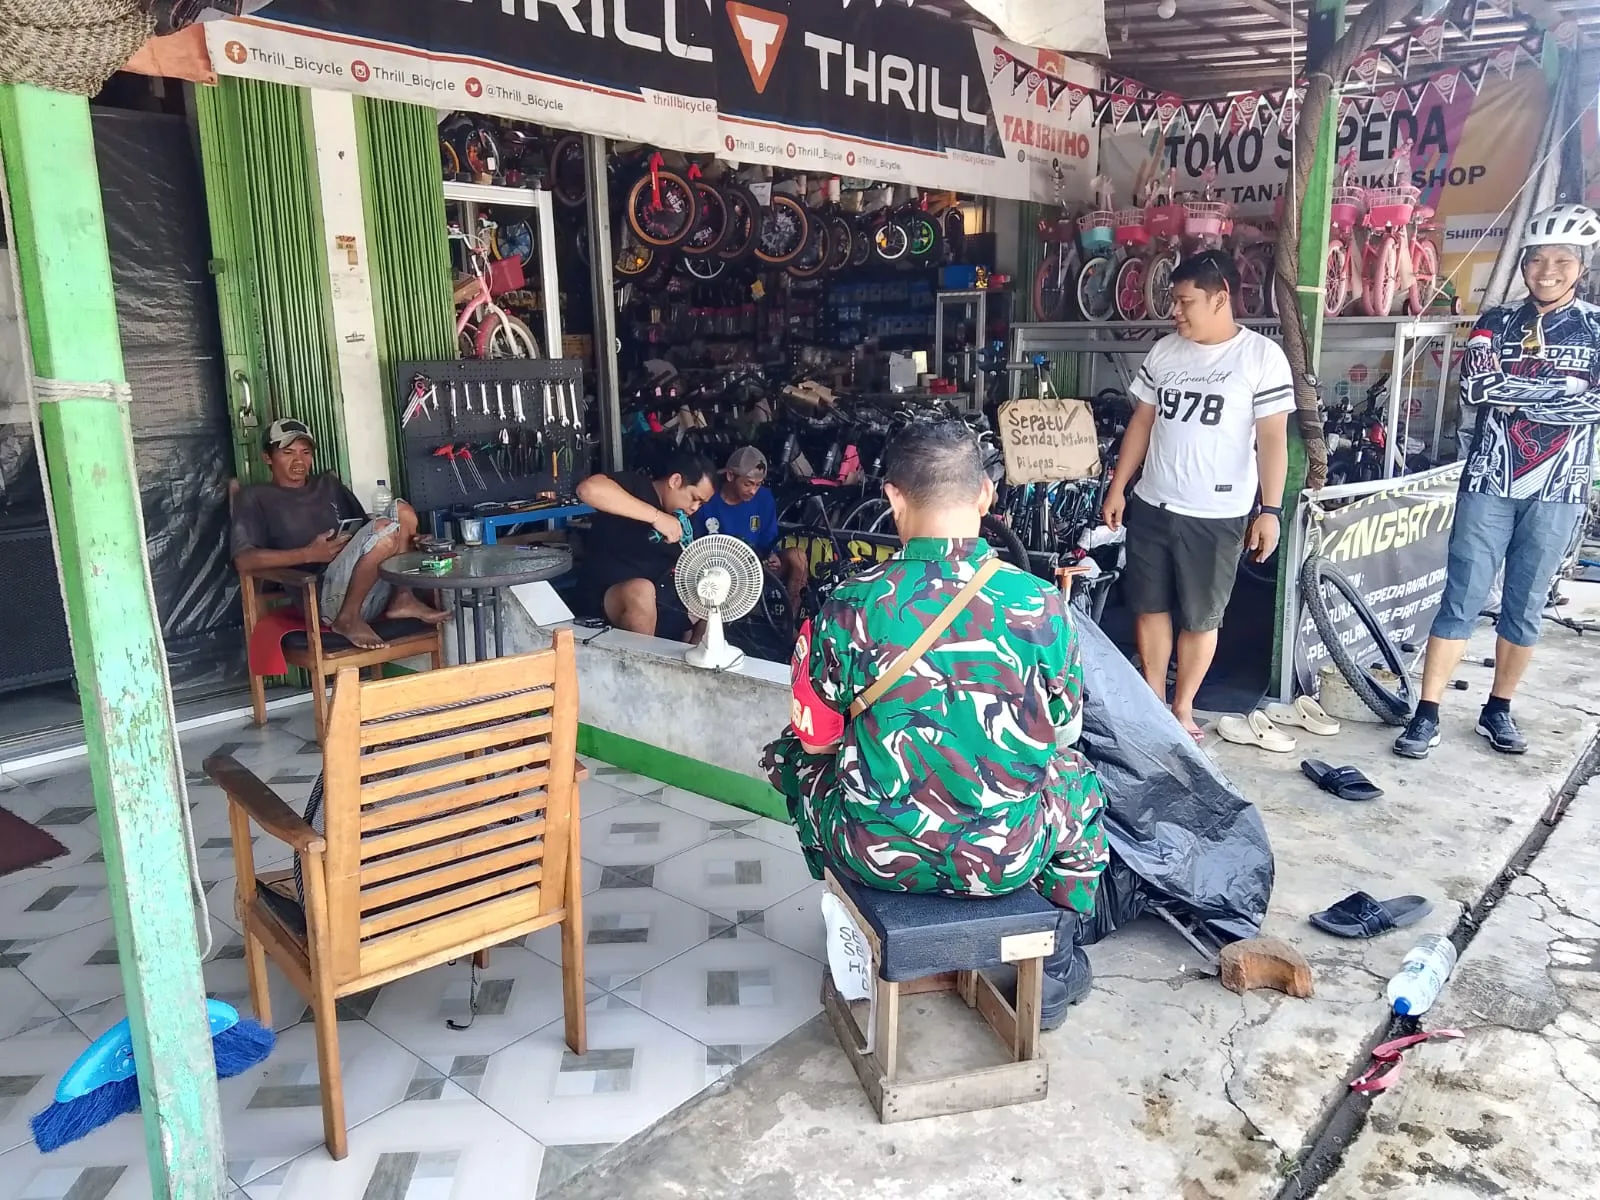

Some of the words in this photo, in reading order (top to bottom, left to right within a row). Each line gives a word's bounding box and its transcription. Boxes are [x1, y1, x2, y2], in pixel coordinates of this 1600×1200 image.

[249, 47, 344, 76] Thrill_Bicycle
[372, 66, 456, 92] Thrill_Bicycle
[804, 31, 988, 126] THRILL
[486, 84, 564, 111] @Thrill_Bicycle
[1164, 126, 1264, 178] TOKO
[1274, 104, 1449, 169] SPEDA
[1411, 165, 1487, 189] SHOP
[1157, 387, 1225, 426] 1978
[1391, 599, 1421, 621] PART
